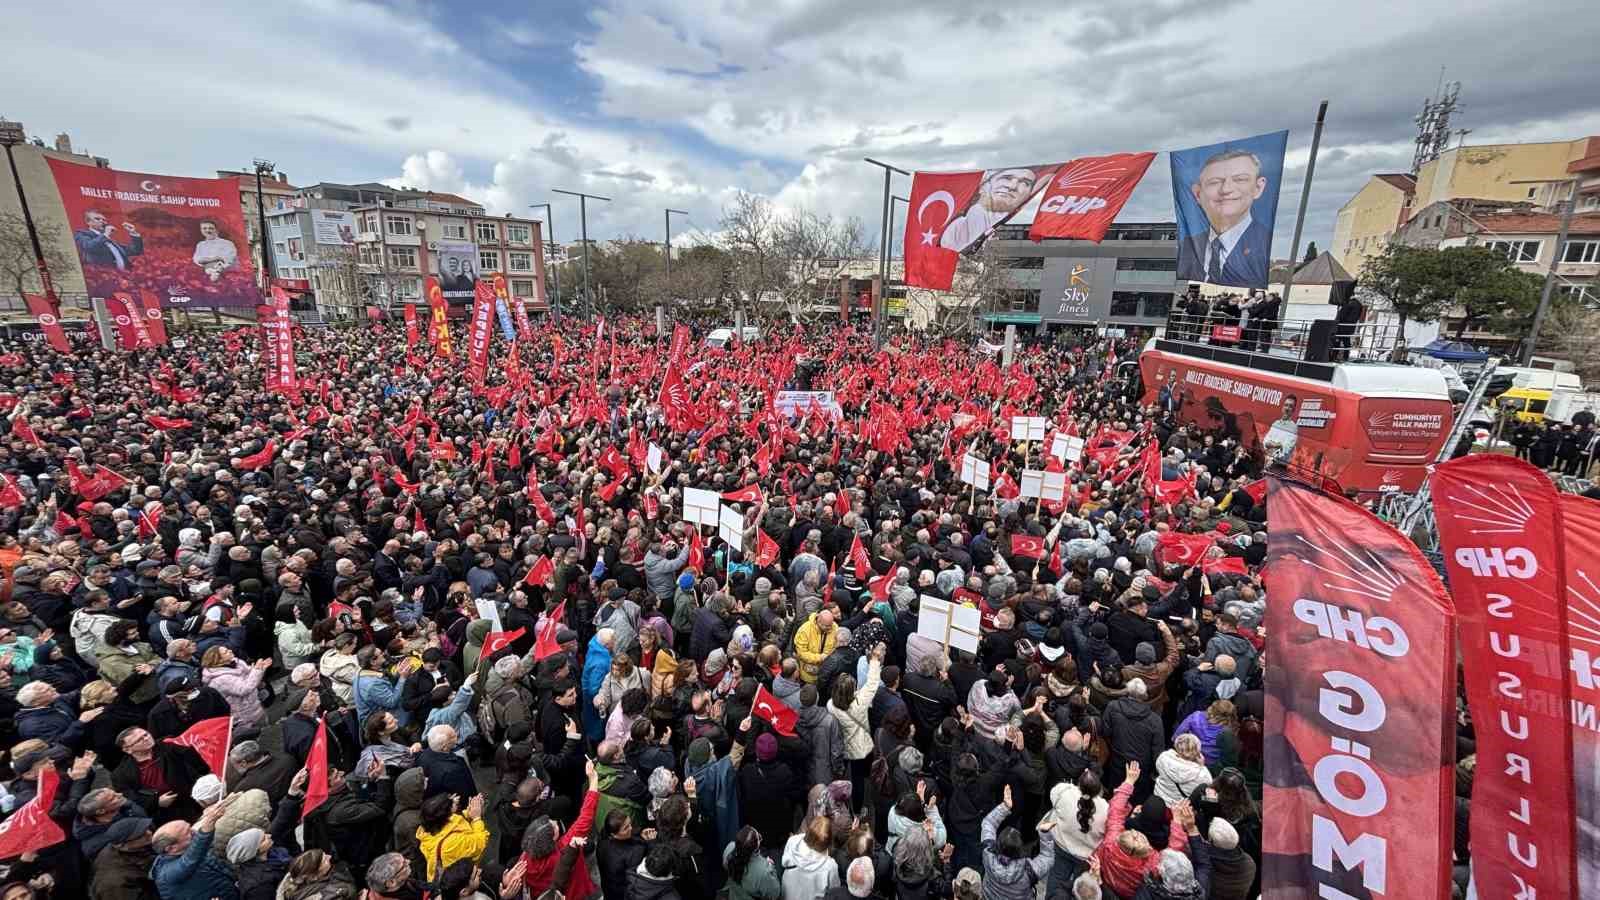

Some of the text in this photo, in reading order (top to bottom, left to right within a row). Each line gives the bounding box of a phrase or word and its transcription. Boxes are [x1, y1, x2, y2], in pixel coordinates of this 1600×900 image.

[1038, 195, 1106, 214] CHP
[1060, 287, 1089, 306] Sky
[1057, 303, 1089, 314] fitness
[1393, 413, 1442, 421] CUMHURİYET
[1413, 421, 1441, 429] PARTİSİ
[1378, 484, 1401, 492] CHP
